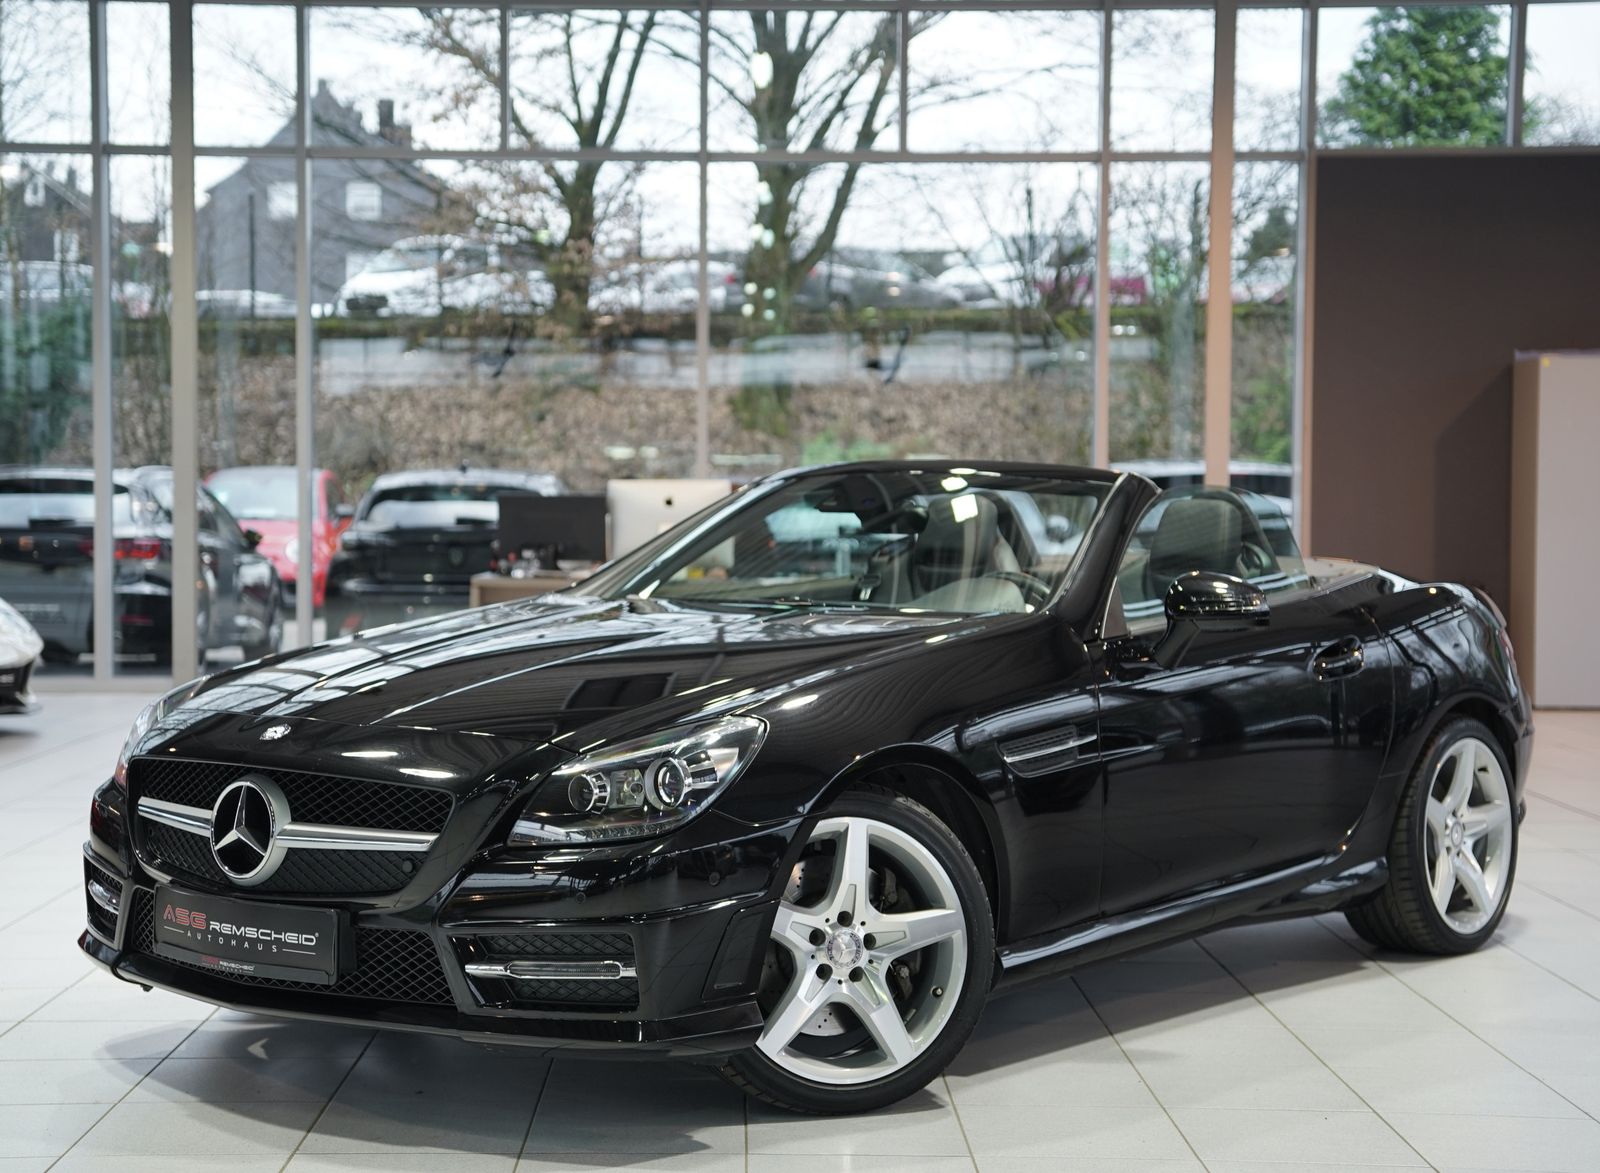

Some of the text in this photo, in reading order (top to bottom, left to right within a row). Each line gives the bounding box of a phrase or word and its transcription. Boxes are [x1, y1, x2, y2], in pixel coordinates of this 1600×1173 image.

[163, 904, 317, 946] ASG REMSCHEID
[187, 930, 277, 952] AUTOHAUS
